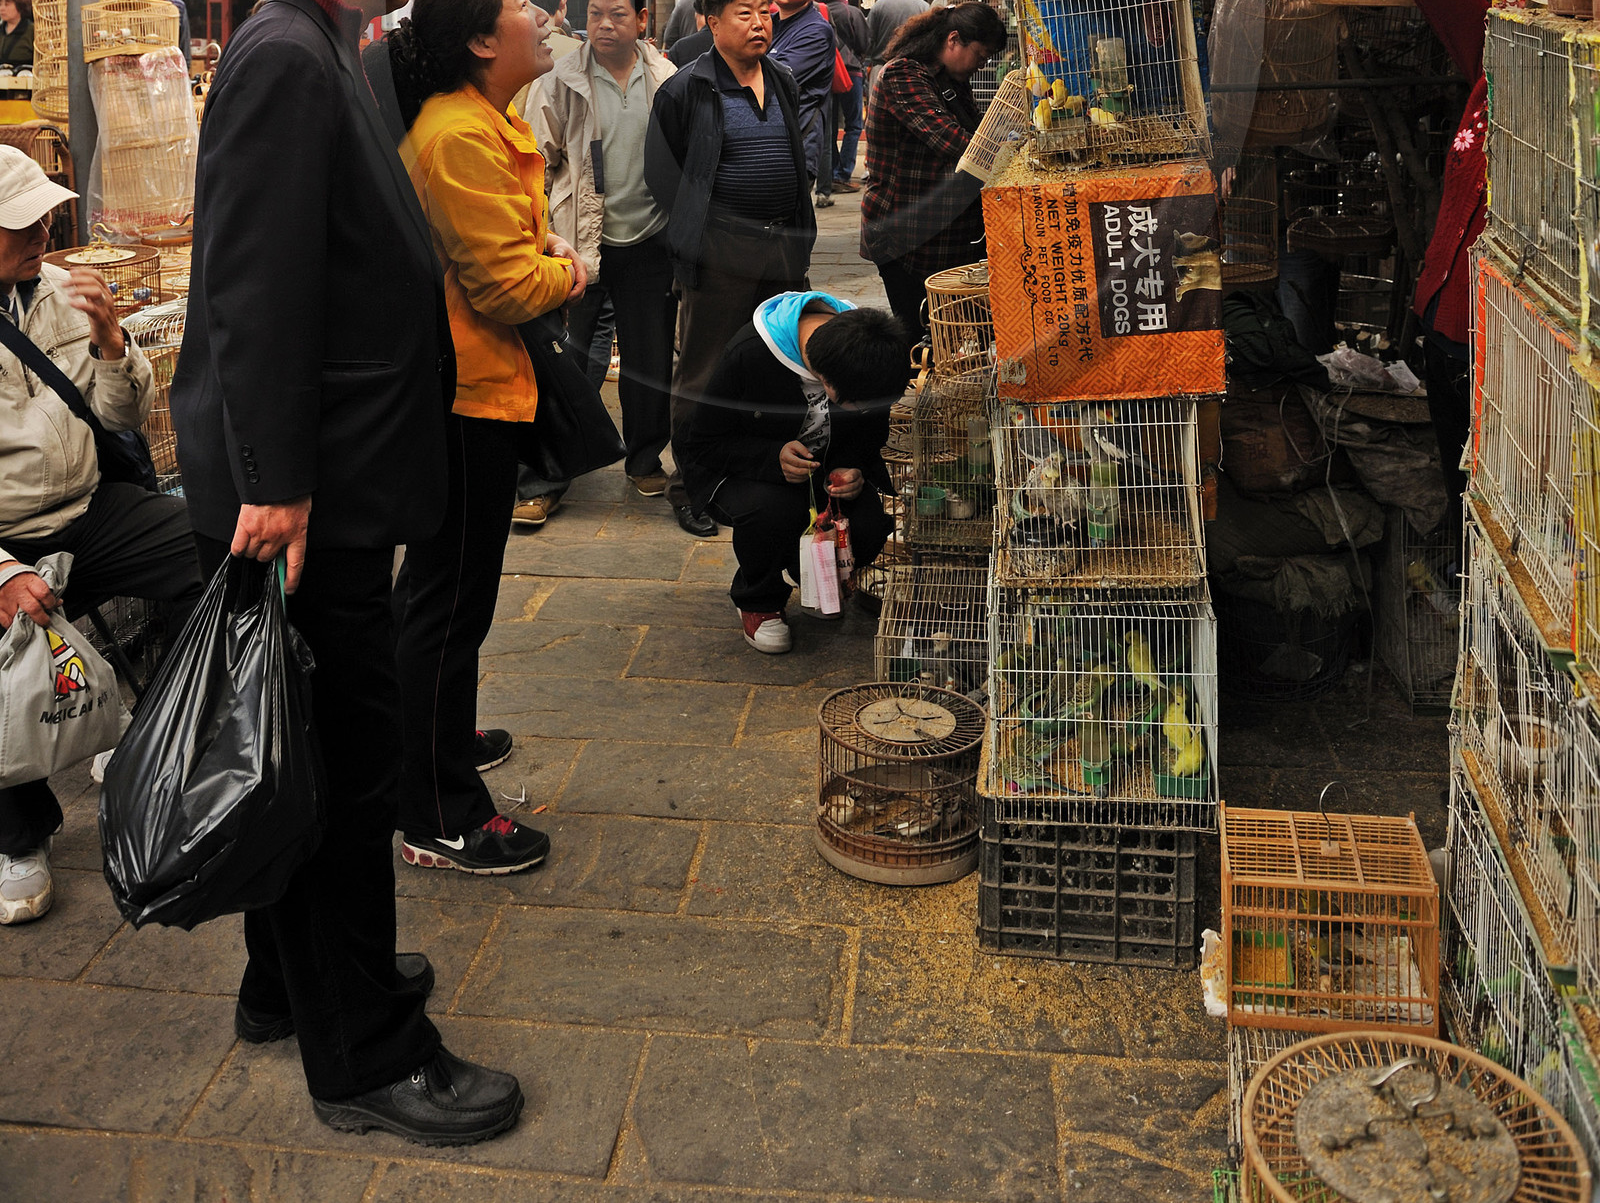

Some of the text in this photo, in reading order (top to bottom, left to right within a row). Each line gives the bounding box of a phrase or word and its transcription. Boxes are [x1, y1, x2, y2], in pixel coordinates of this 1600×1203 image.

[1031, 185, 1046, 238] UANGZUN
[1046, 198, 1061, 232] NET
[1038, 245, 1049, 268] PET
[1102, 204, 1131, 335] ADULT DOGS
[1126, 204, 1168, 332] 成犬专用
[1041, 274, 1052, 305] FOOD
[1049, 344, 1059, 368] LTD
